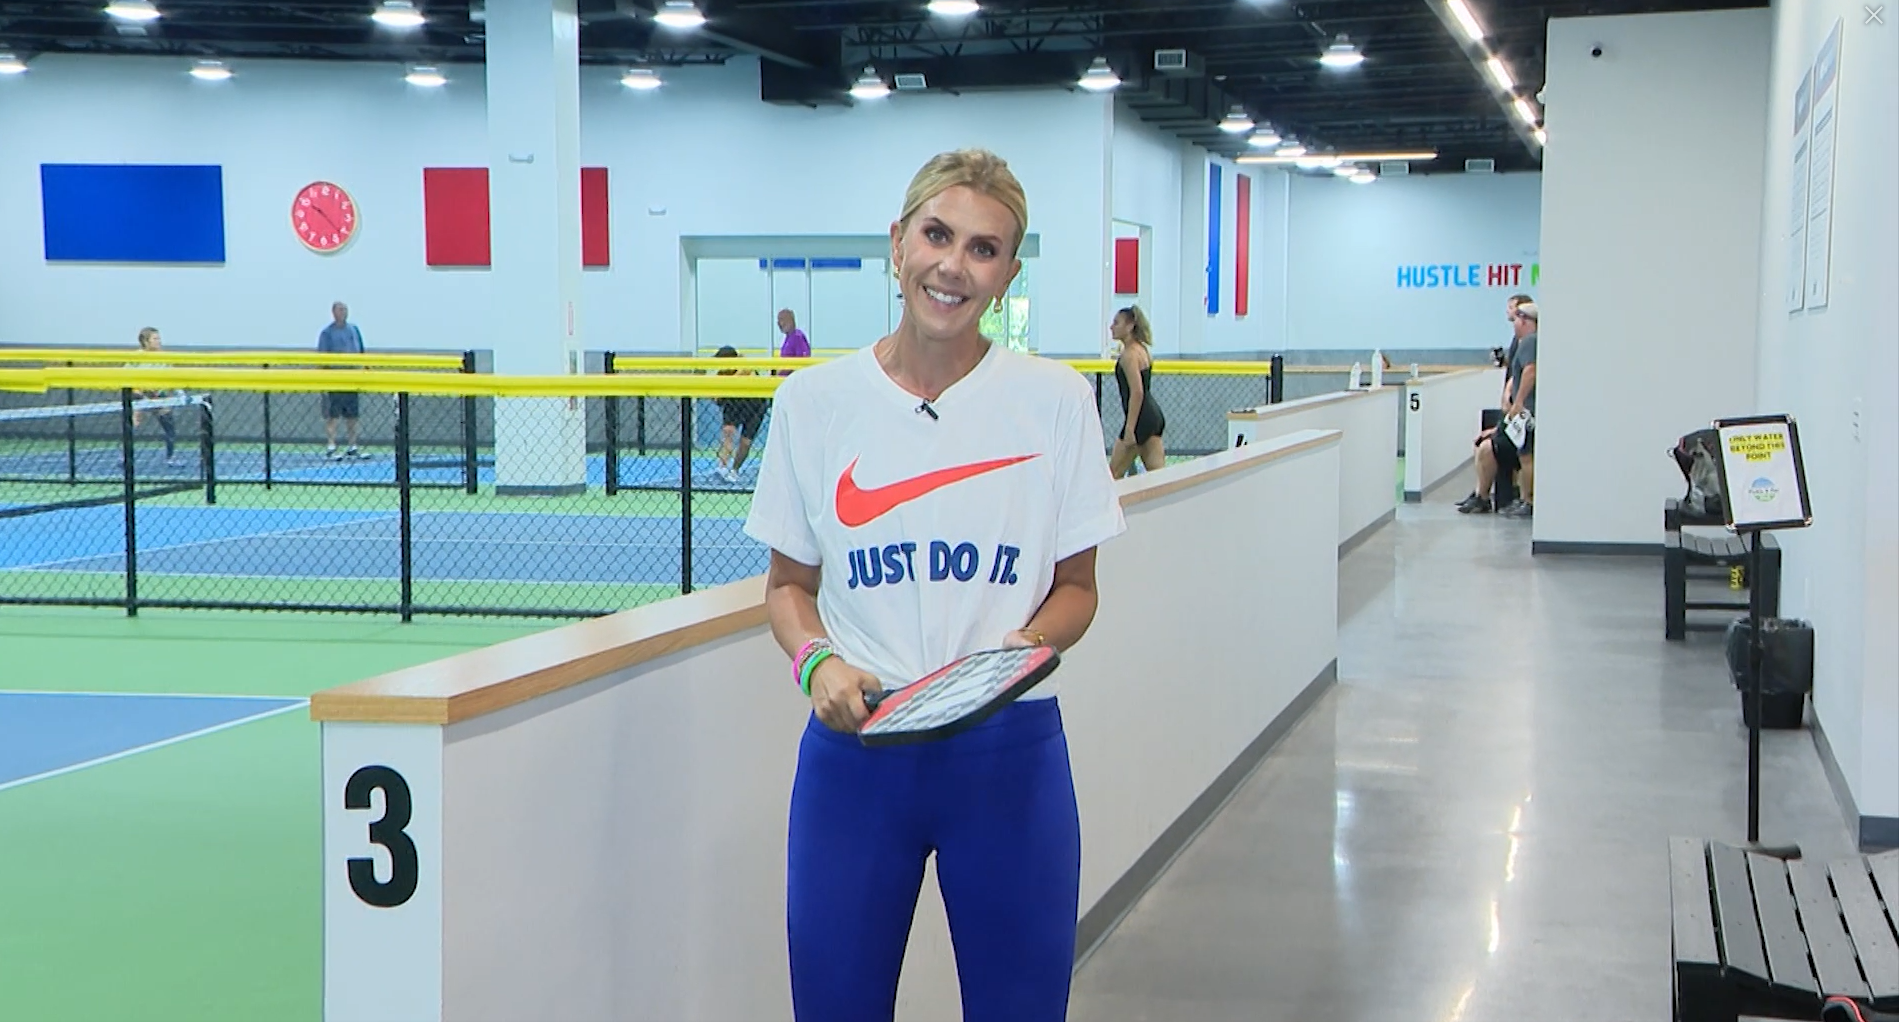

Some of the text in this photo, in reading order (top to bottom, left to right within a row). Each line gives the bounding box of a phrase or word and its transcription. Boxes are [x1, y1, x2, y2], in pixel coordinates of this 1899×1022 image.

[1397, 264, 1480, 287] HUSTLE
[1488, 264, 1523, 287] HIT
[1409, 393, 1420, 412] 5
[1730, 444, 1766, 452] BEYOND
[1746, 452, 1771, 460] POINT
[848, 541, 917, 589] JUST
[930, 540, 979, 582] DO
[344, 765, 420, 908] 3
